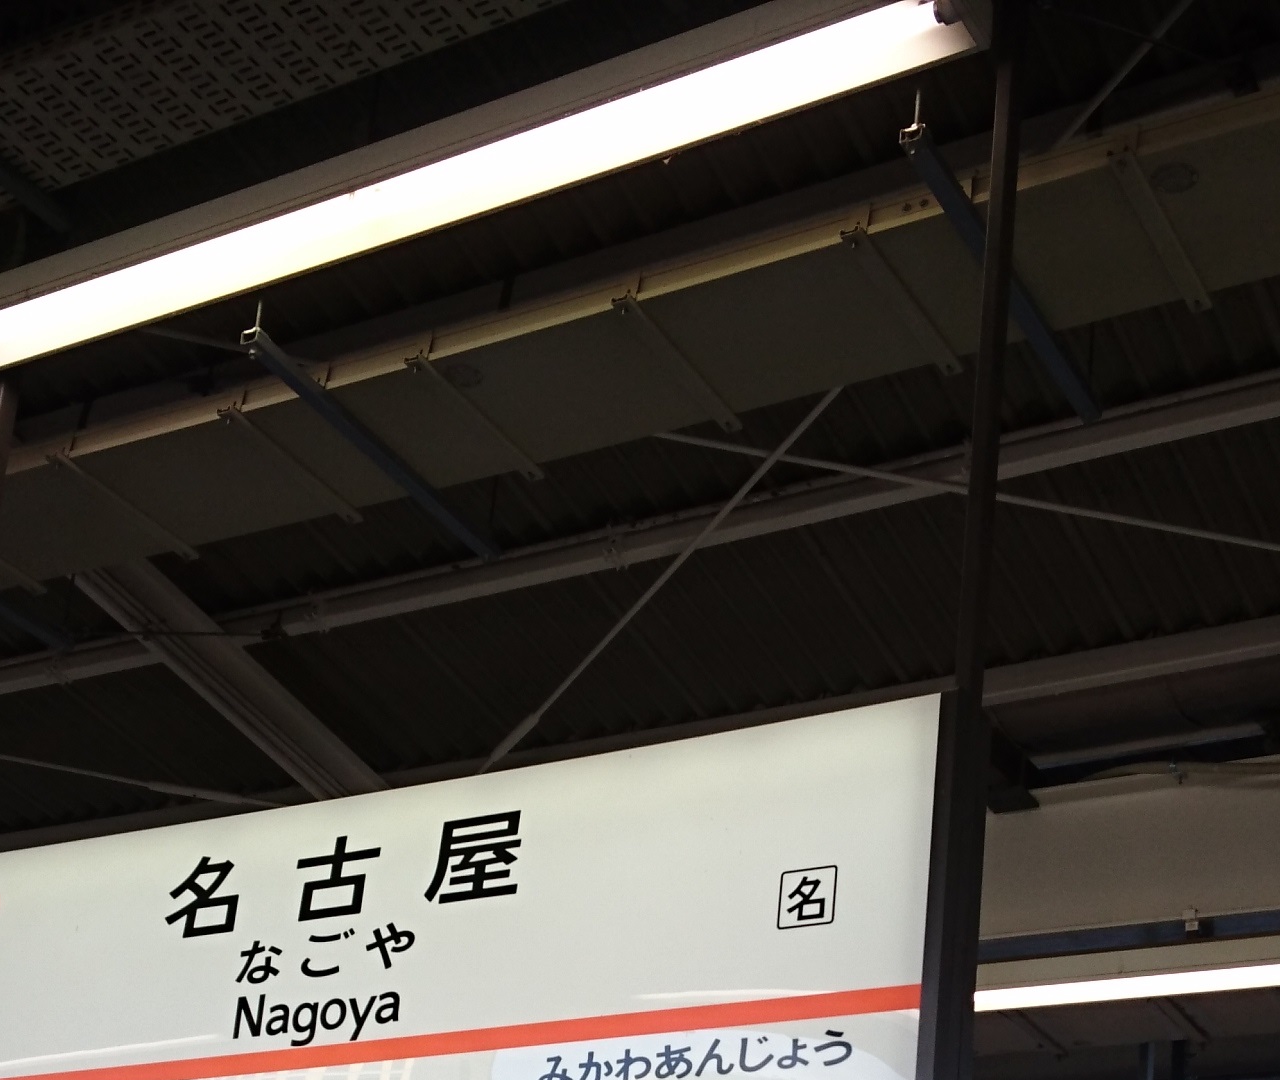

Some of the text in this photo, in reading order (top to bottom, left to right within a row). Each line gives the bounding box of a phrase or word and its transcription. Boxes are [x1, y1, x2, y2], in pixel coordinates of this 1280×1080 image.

[164, 810, 522, 938] 名古屋
[786, 876, 825, 921] 名
[235, 922, 416, 984] なごや
[232, 991, 401, 1047] Nagoya
